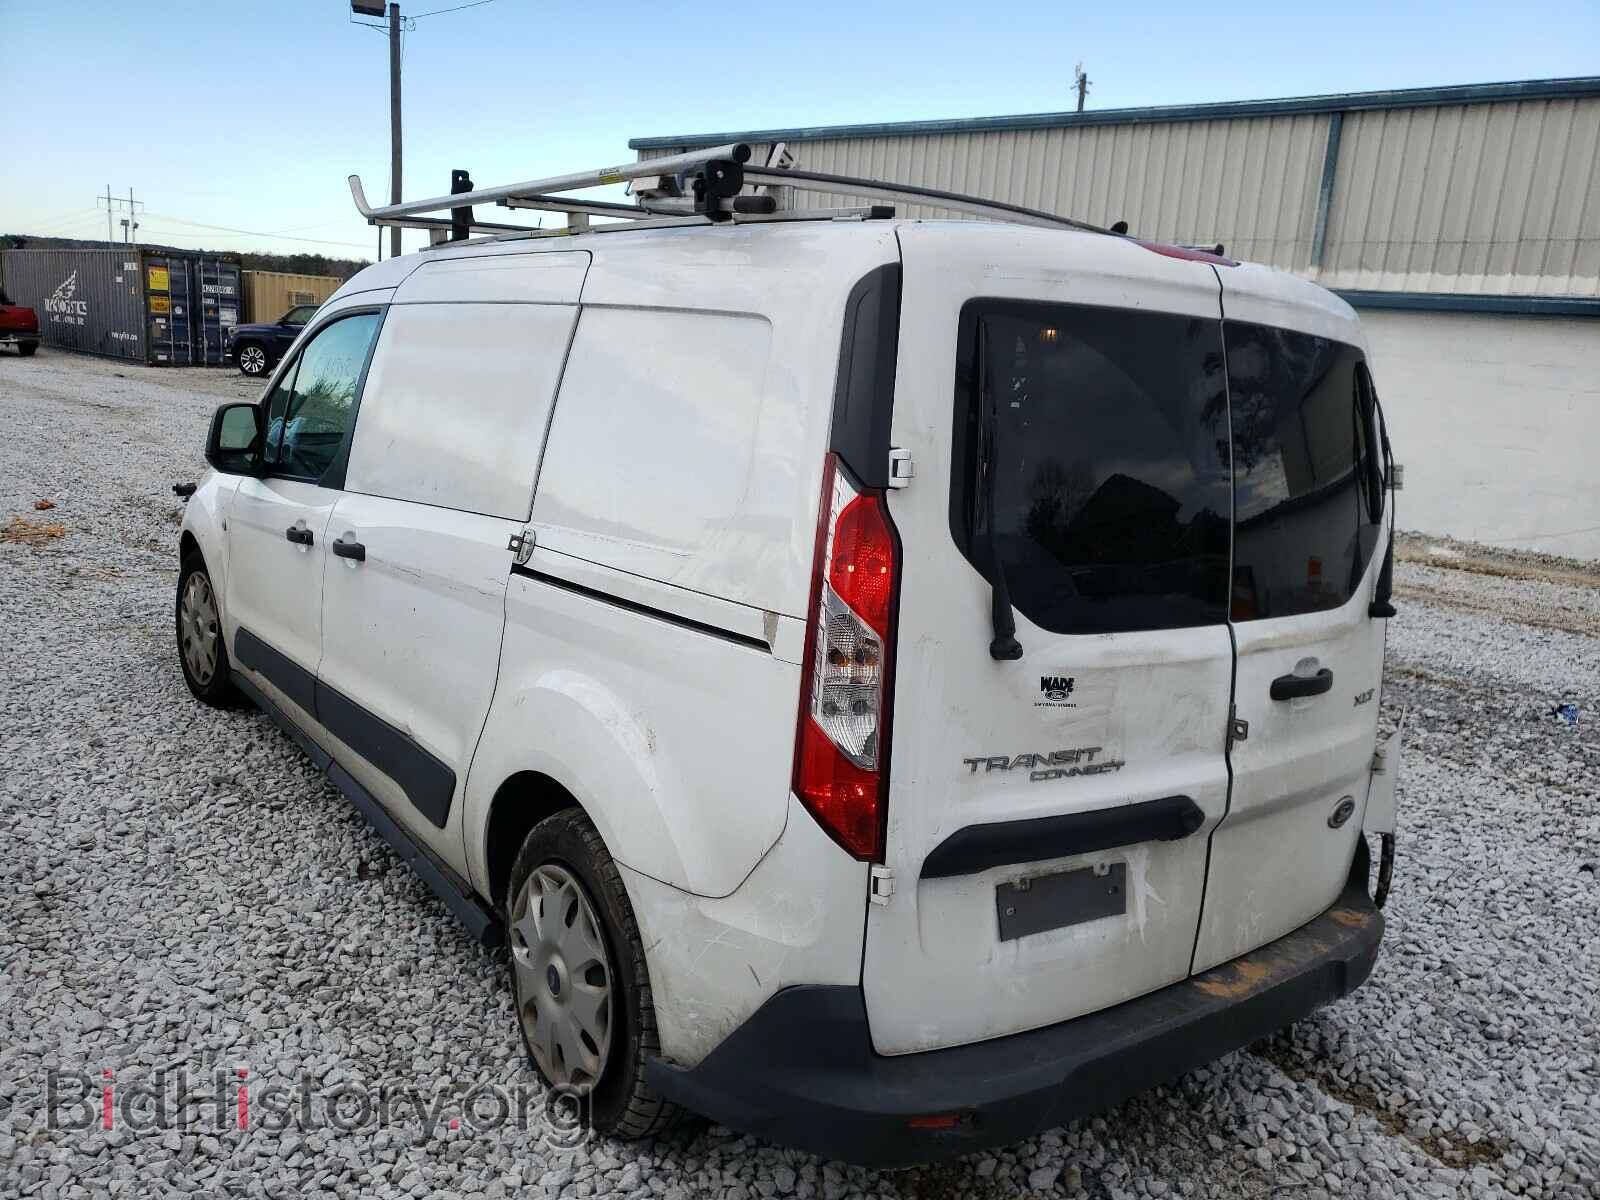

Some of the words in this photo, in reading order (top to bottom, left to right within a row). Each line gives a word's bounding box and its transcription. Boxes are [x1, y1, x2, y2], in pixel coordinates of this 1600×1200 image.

[1040, 676, 1074, 692] WADE
[1353, 688, 1375, 707] XLT
[963, 746, 1102, 775] TRANSIT
[1029, 760, 1126, 782] CONNECT
